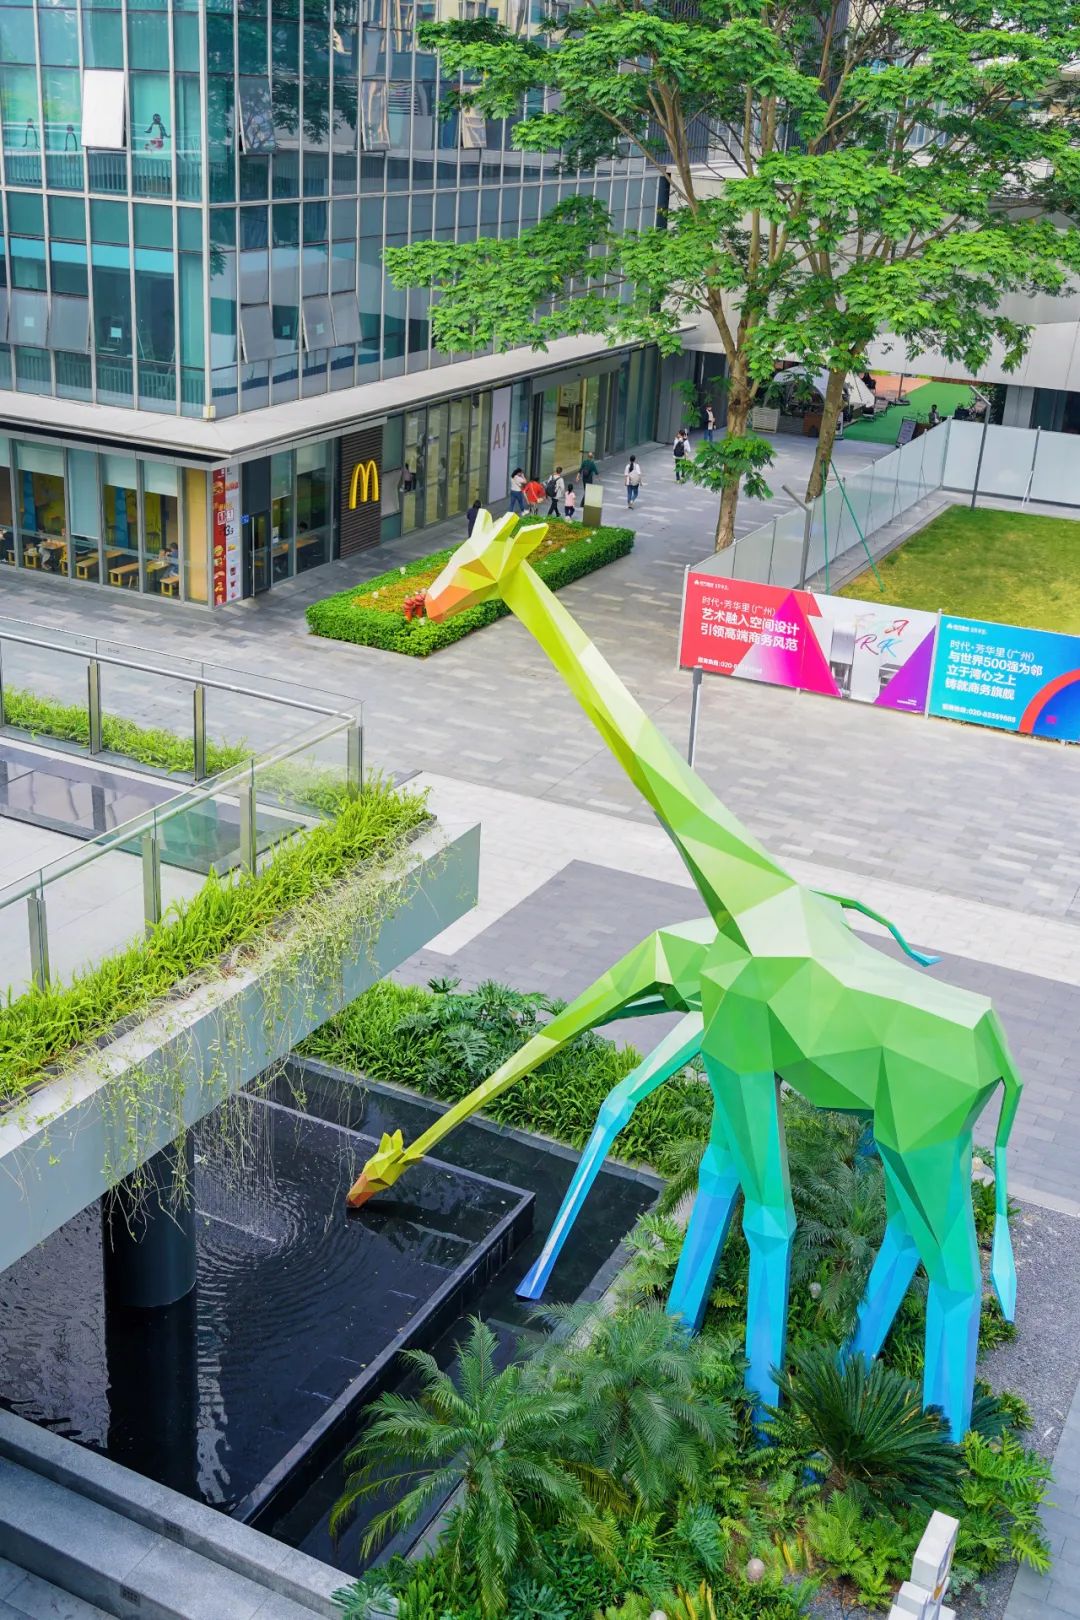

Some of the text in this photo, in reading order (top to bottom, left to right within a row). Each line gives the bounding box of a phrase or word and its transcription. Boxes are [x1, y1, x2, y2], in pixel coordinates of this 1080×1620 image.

[493, 421, 506, 450] A1
[702, 607, 800, 636] 艺术融入空间设计
[701, 622, 799, 651] 引领高端商务风范
[949, 650, 1043, 676] 与世界500强为邻
[945, 677, 1015, 700] 铸就商务旗舰
